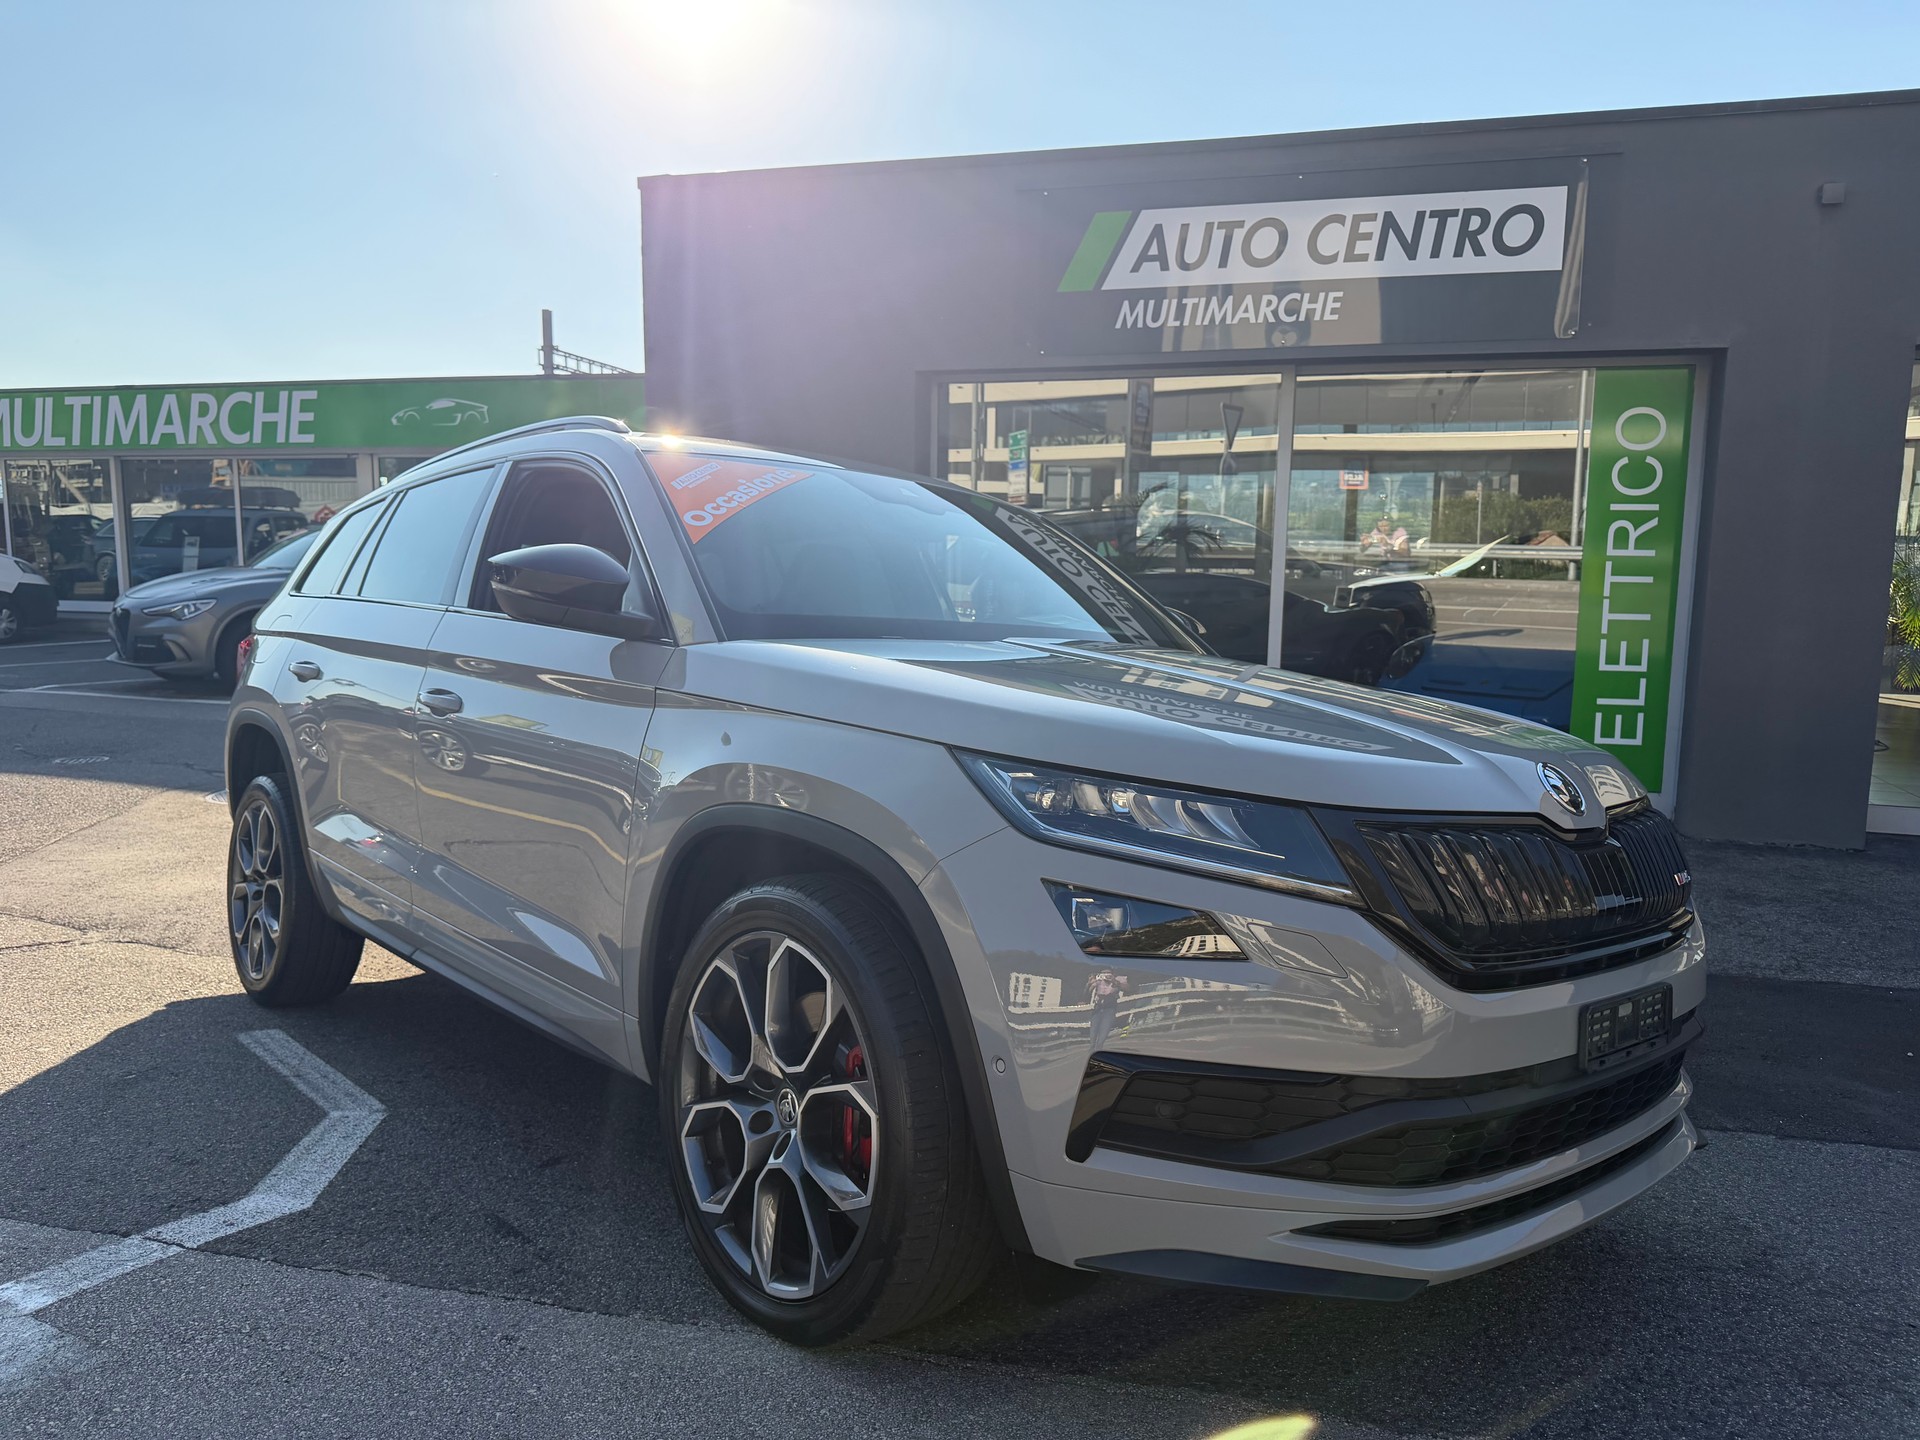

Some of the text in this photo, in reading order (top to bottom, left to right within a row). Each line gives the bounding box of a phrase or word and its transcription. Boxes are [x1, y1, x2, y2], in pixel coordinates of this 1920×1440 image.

[1130, 203, 1545, 273] AUTO CENTRO
[1115, 291, 1344, 330] MULTIMARCHE
[683, 468, 797, 526] Occasione
[1594, 406, 1667, 746] ELETTRICO
